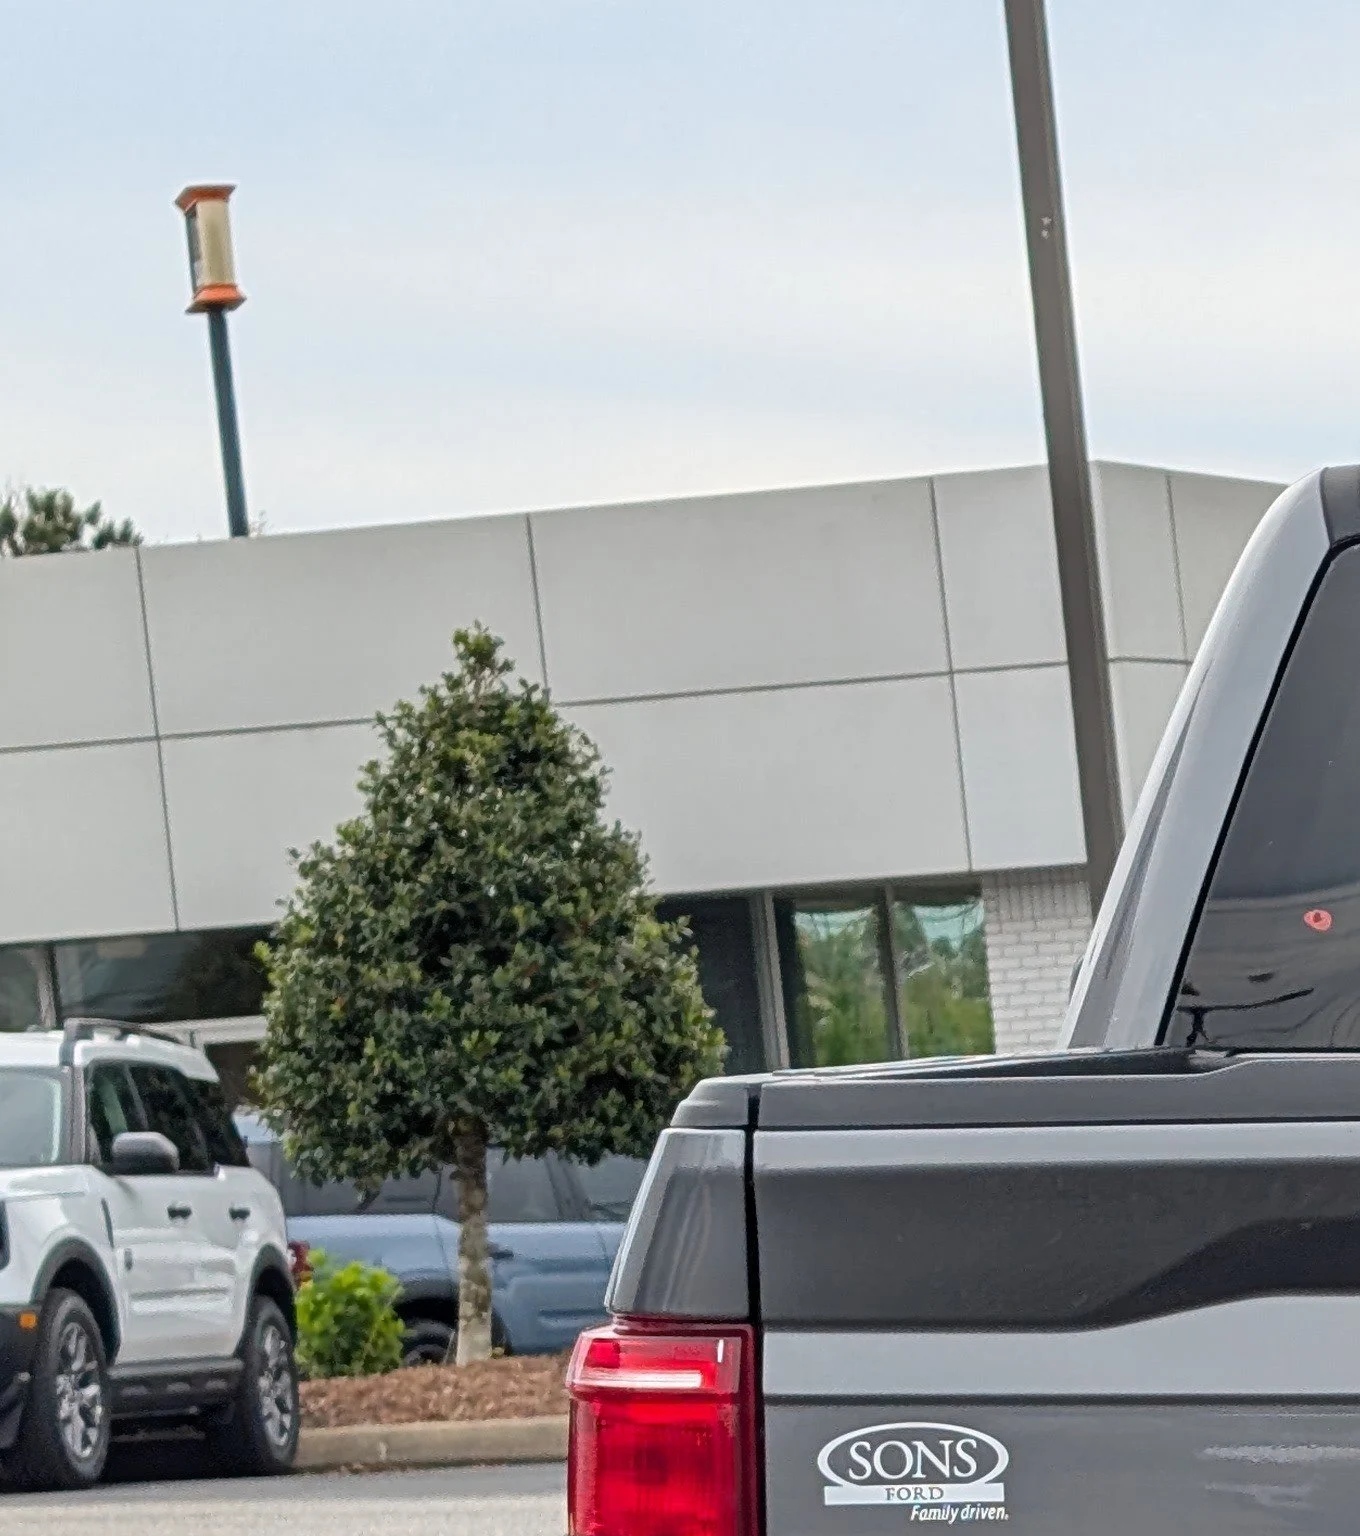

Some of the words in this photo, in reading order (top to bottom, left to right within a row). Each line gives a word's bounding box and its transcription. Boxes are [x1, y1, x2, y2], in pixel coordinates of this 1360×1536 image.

[849, 1439, 977, 1480] SONS
[885, 1486, 945, 1501] FORD
[910, 1503, 959, 1525] Family
